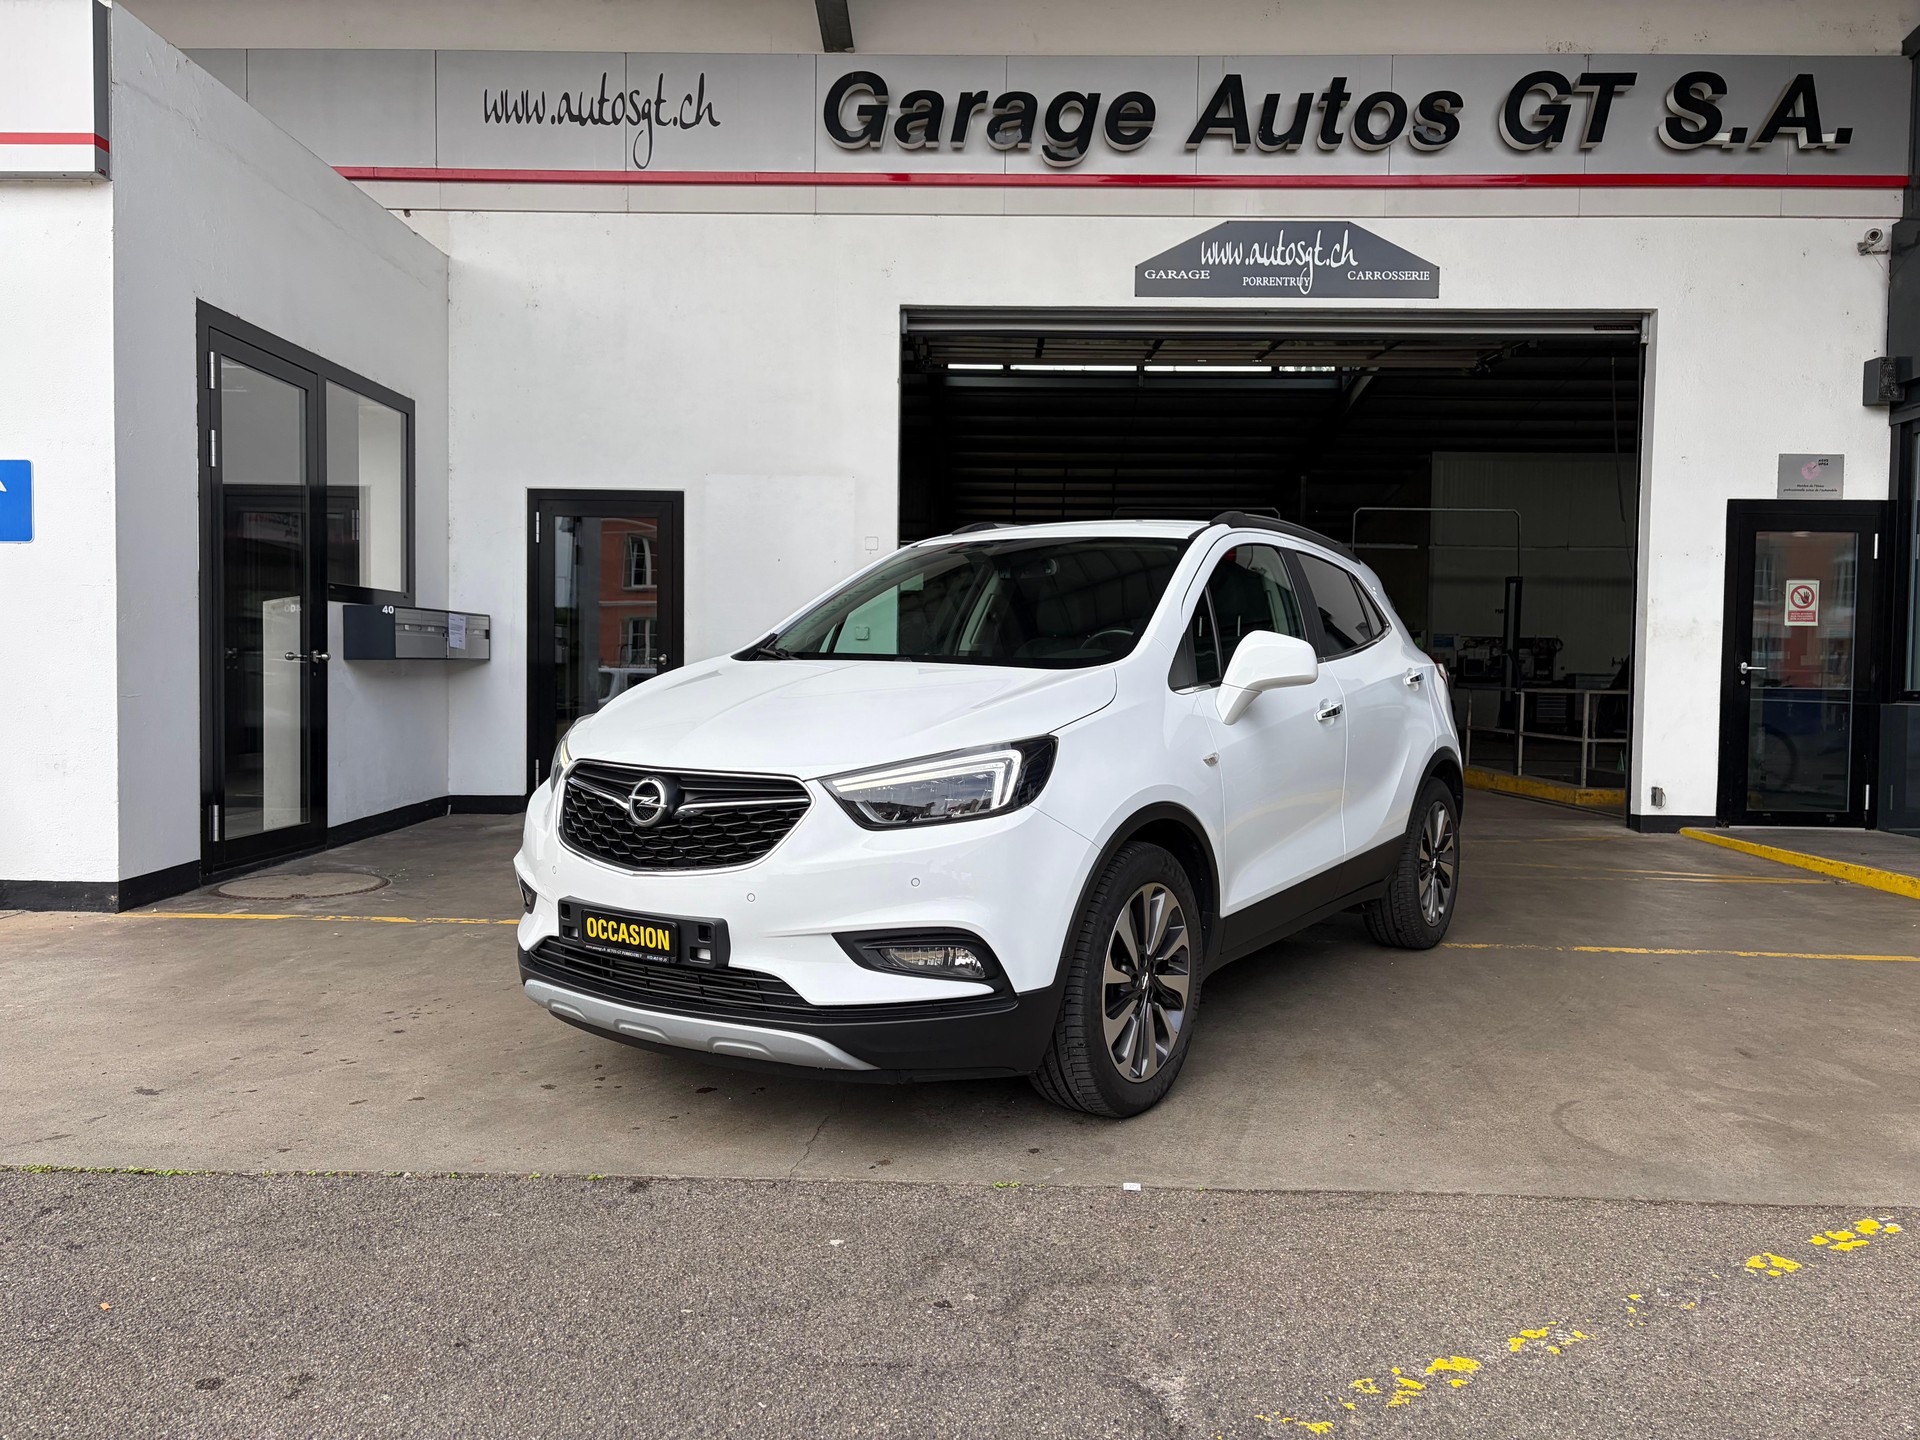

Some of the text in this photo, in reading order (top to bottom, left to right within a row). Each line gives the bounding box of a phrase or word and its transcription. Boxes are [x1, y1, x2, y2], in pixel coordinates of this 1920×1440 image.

[483, 72, 721, 169] www.autosgt.ch
[823, 70, 1854, 168] Garage Autos GT S.A.
[1200, 229, 1358, 295] www.autosgt.ch
[1144, 269, 1211, 280] GARAGE
[1242, 276, 1311, 288] PORRENTRUY
[1347, 270, 1431, 281] CARROSSERIE
[382, 605, 394, 614] 40
[586, 917, 671, 951] OCCASION
